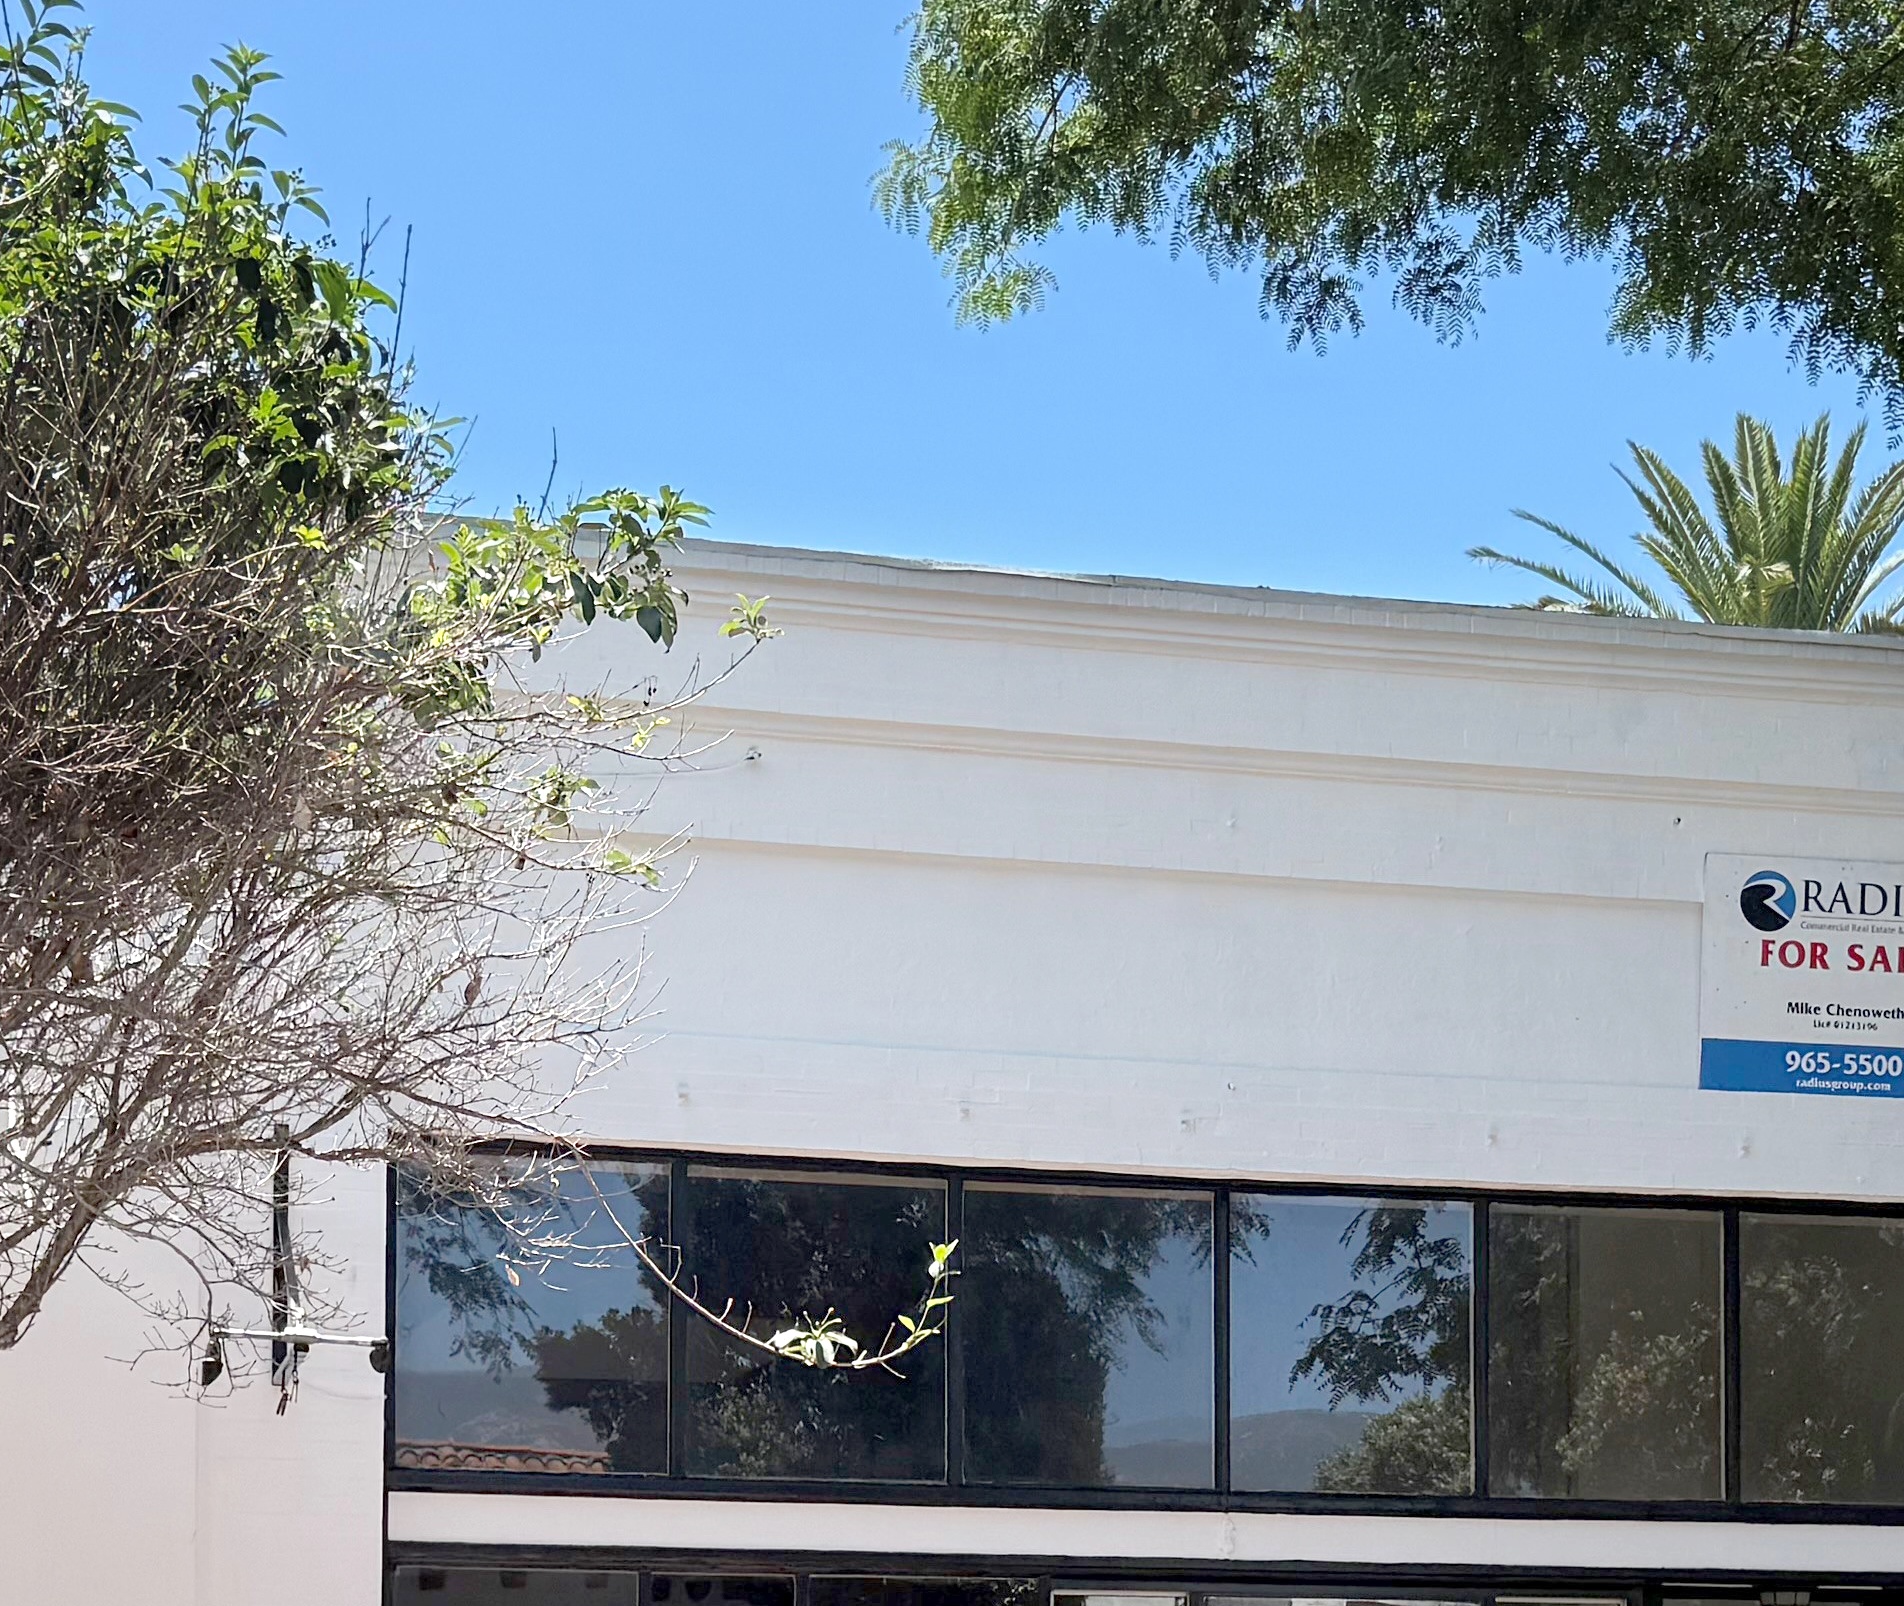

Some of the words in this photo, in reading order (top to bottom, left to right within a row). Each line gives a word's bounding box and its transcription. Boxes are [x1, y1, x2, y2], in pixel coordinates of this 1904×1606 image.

[1800, 921, 1850, 932] Commercial
[1851, 924, 1869, 932] Real
[1871, 925, 1896, 934] Estate
[1761, 940, 1830, 970] FOR
[1787, 1002, 1821, 1015] Mike
[1826, 1004, 1904, 1019] Chenoweth
[1785, 1051, 1903, 1077] 965-5500
[1796, 1077, 1891, 1092] radiusgroup.com
